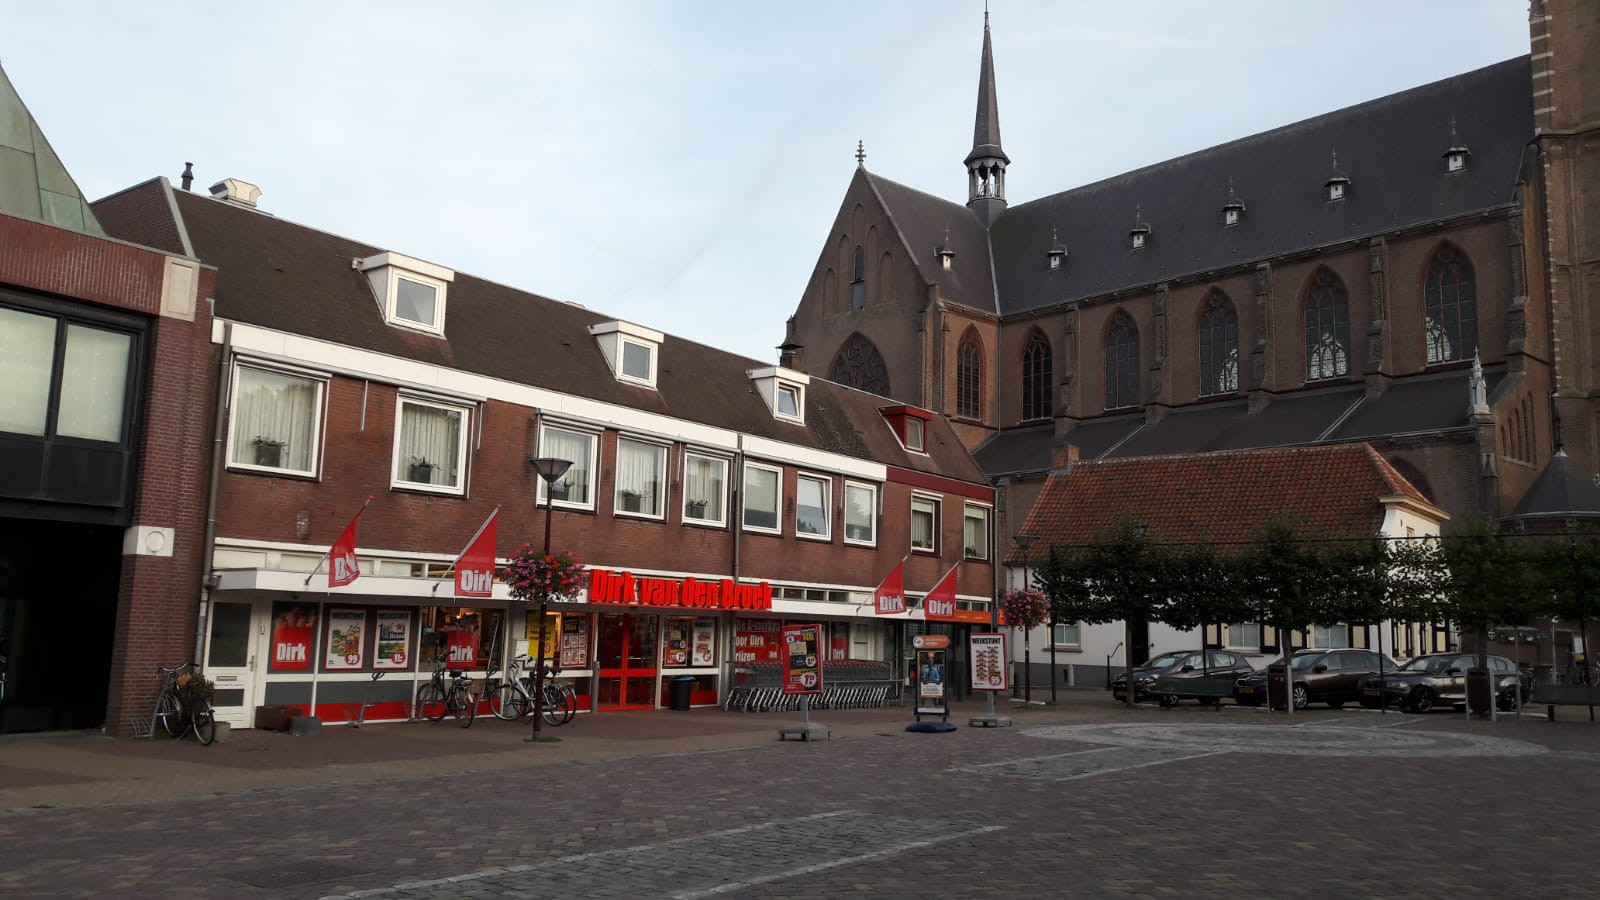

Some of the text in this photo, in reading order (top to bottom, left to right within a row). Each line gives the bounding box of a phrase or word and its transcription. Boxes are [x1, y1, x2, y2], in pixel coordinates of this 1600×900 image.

[461, 570, 493, 592] Dirk
[589, 569, 773, 610] Dirk van den Broek
[880, 595, 904, 611] Dirk
[929, 600, 953, 616] Dirk
[736, 635, 764, 646] oor Dirk
[276, 642, 306, 662] Dirk
[450, 645, 473, 662] Dirk
[736, 651, 756, 662] rijzen
